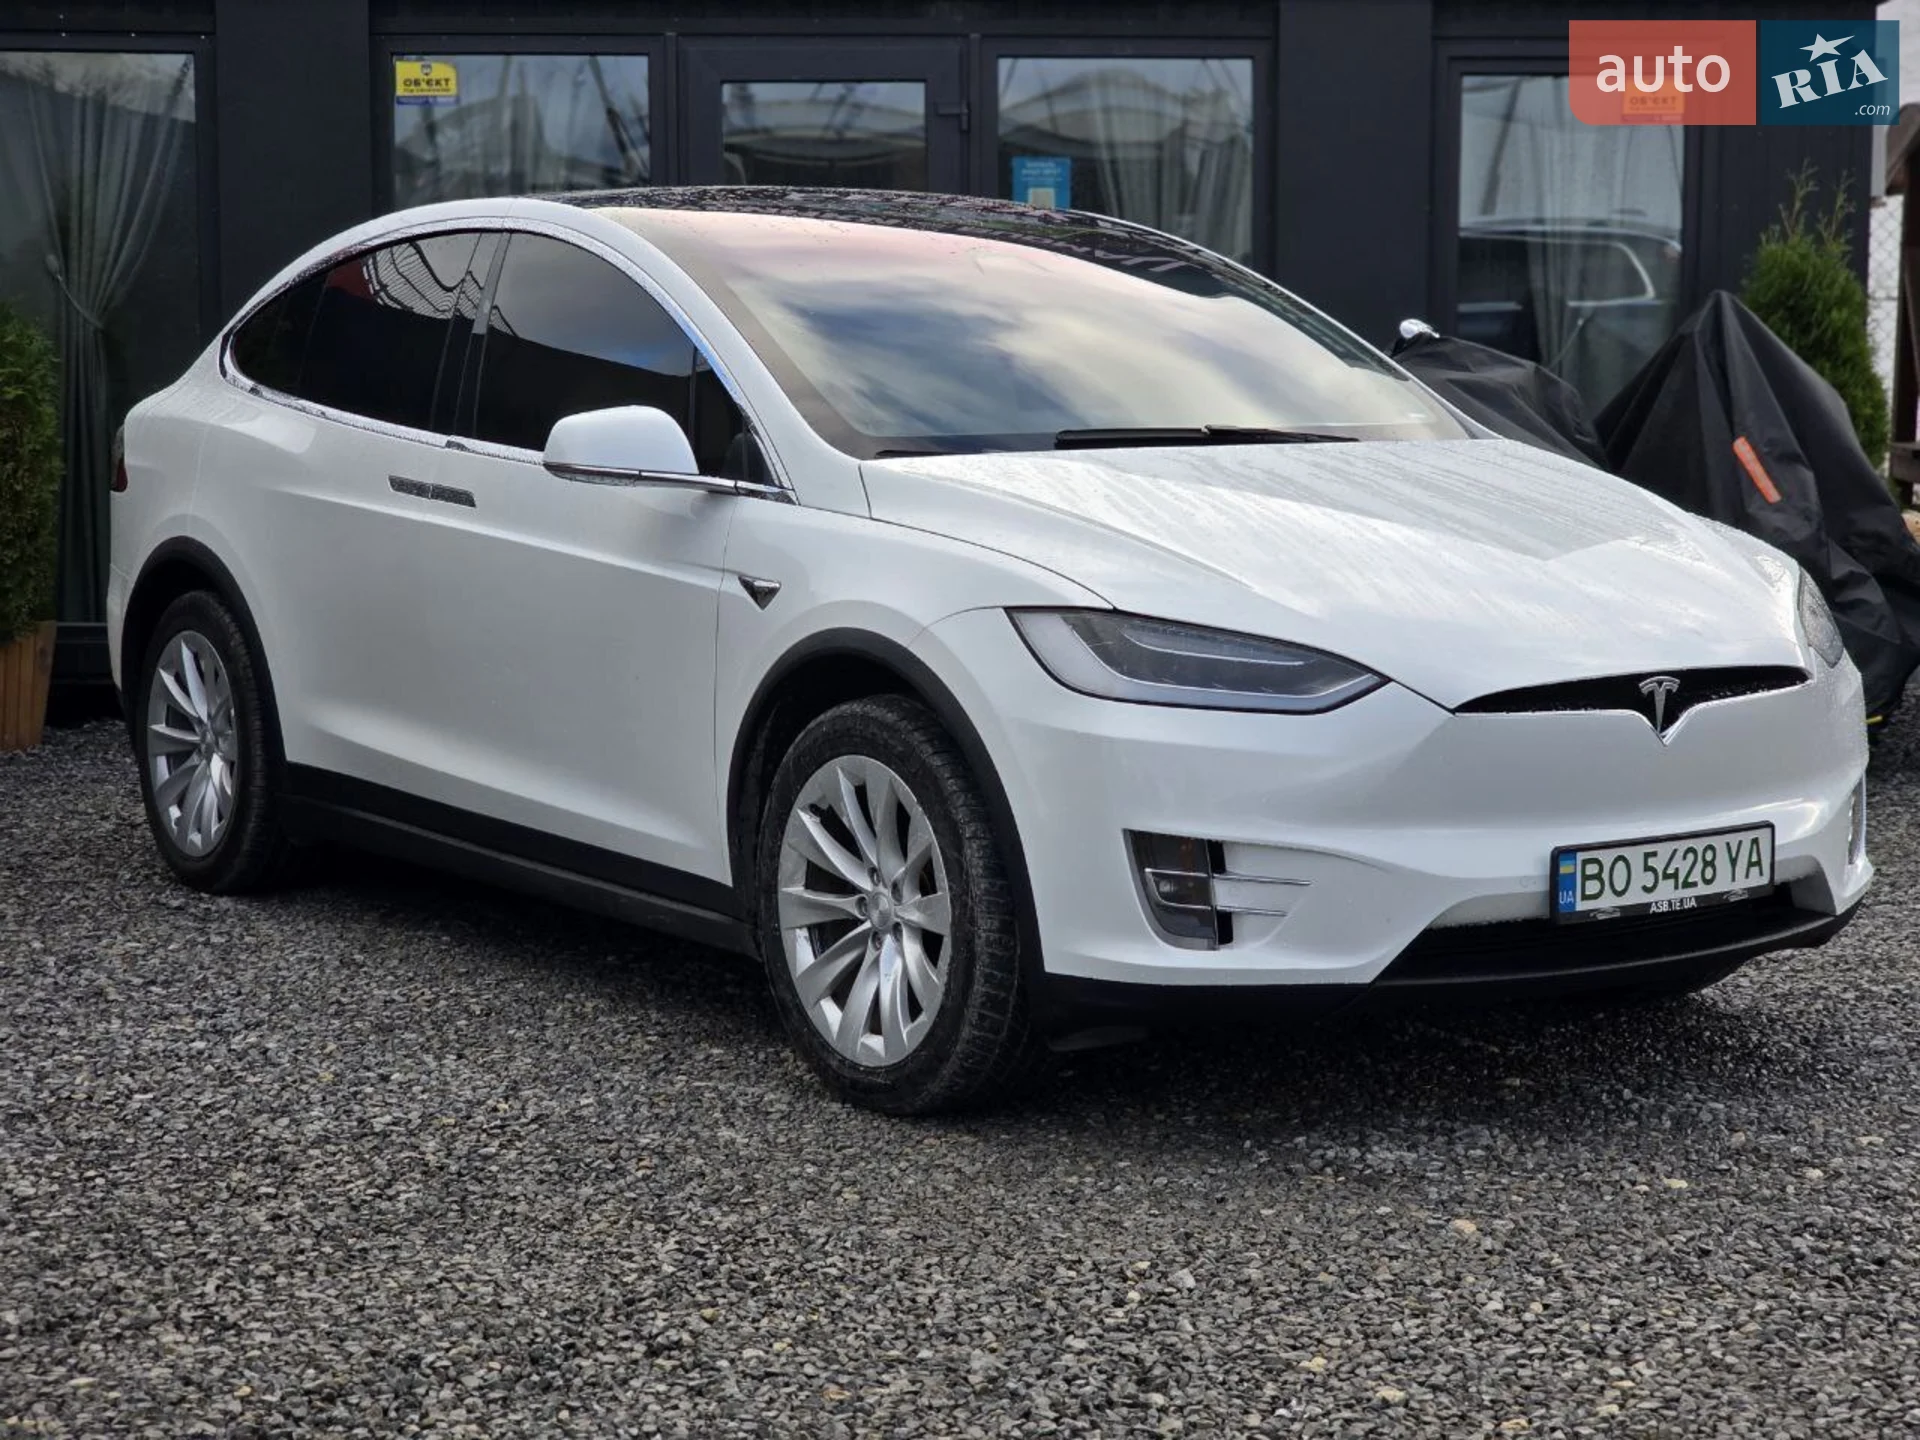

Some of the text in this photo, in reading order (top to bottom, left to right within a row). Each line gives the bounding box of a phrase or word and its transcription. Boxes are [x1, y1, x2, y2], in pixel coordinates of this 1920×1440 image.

[1580, 836, 1764, 902] BO 5428 YA
[1559, 891, 1574, 905] UA
